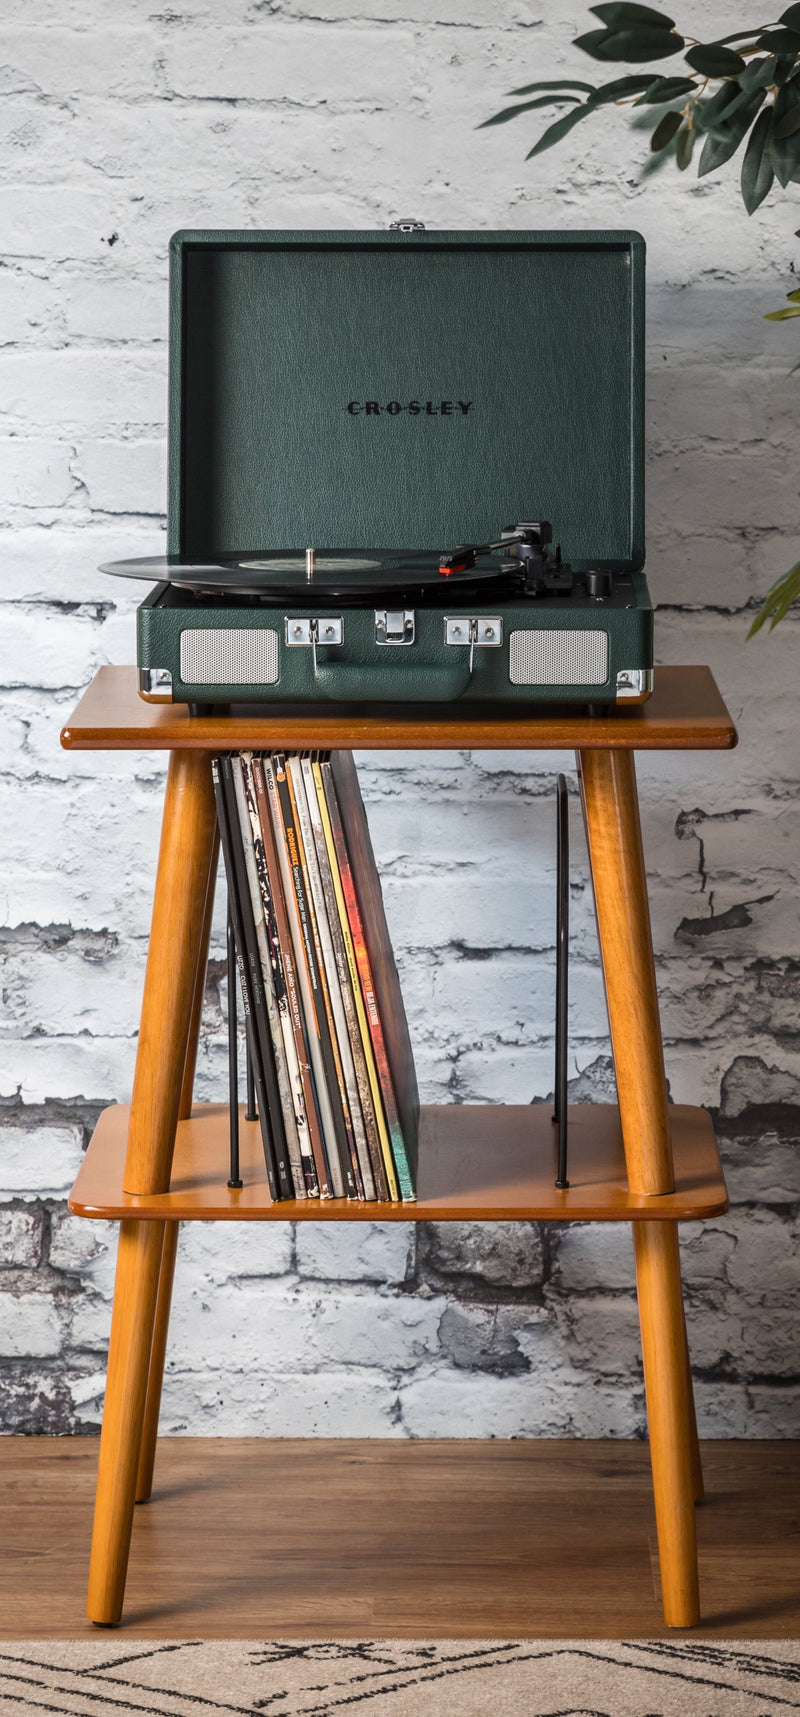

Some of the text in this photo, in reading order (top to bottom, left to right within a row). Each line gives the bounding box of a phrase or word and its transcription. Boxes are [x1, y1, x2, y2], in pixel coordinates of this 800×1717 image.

[346, 401, 473, 416] CROSLEY
[266, 768, 275, 790] WILCO
[273, 810, 281, 829] WARS
[287, 827, 299, 866] RODRIGUEZ
[293, 867, 302, 890] Searching
[364, 980, 373, 991] NEW
[290, 988, 299, 1013] "SOULED
[366, 991, 375, 1004] DEJA
[368, 1004, 379, 1025] ENTENDU
